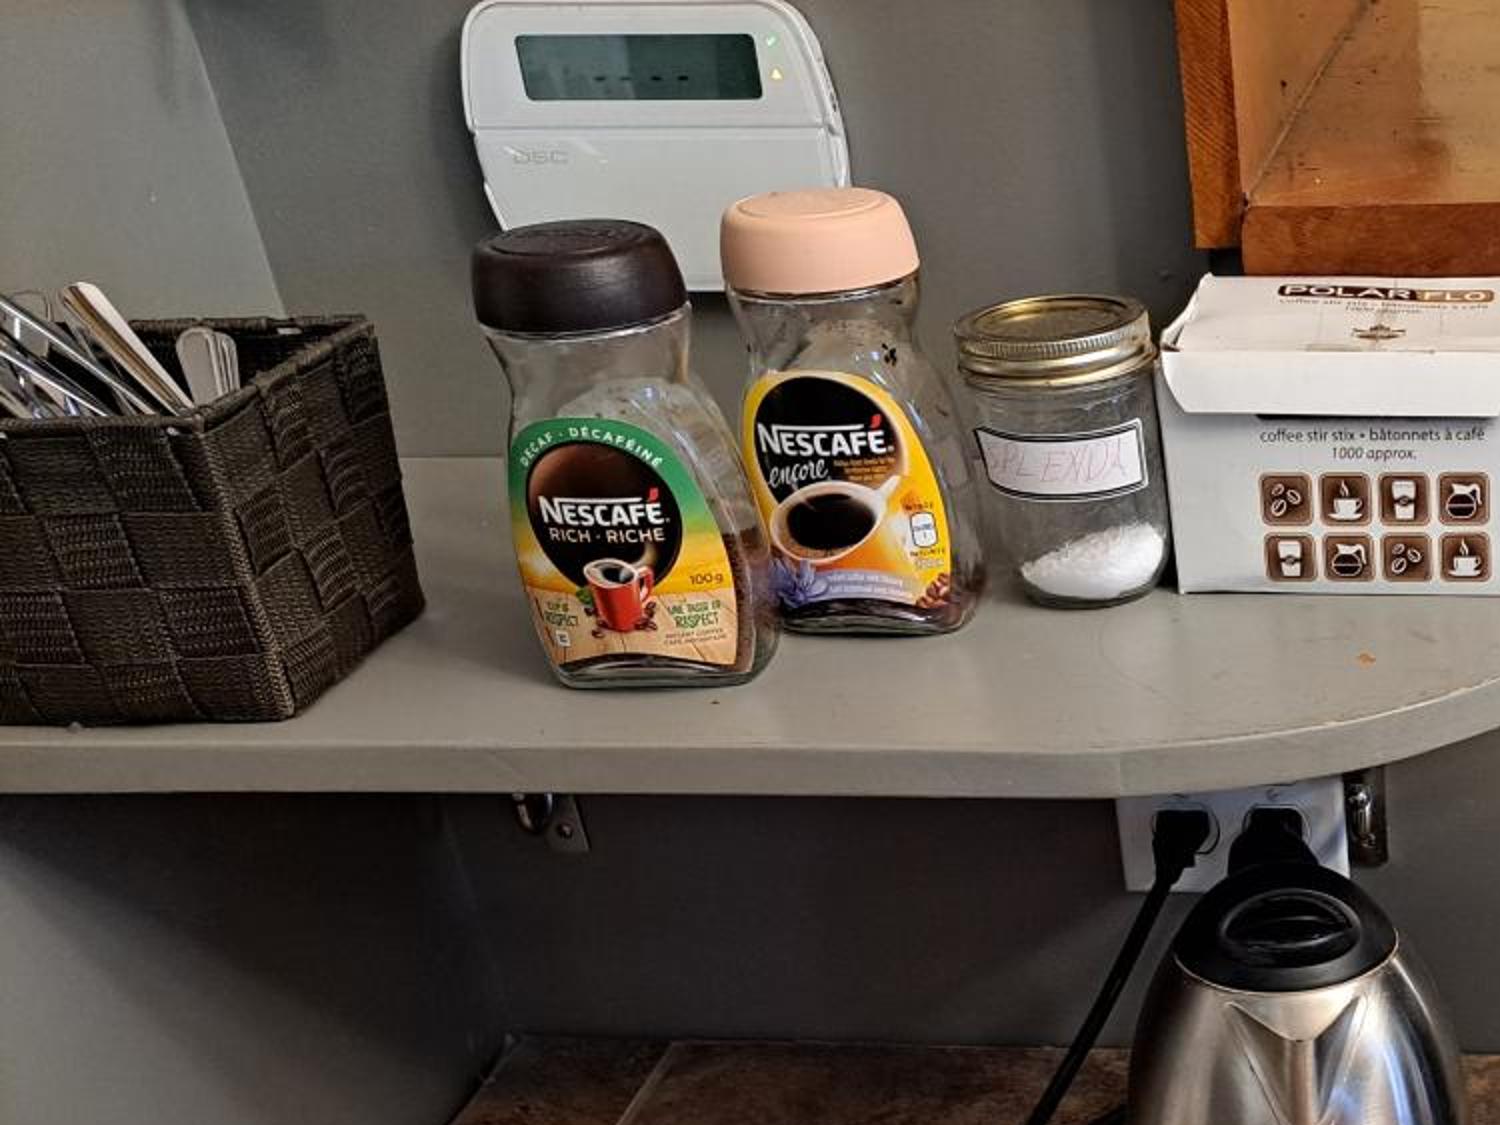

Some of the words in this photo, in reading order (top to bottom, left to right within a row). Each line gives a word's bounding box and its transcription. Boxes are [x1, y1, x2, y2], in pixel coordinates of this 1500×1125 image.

[1284, 286, 1411, 300] POLAR
[1423, 291, 1486, 301] FLO
[758, 414, 887, 457] NESCAFÉ
[1259, 428, 1304, 443] coffee
[1306, 428, 1328, 442] stir
[1330, 428, 1355, 442] stix
[1368, 427, 1441, 442] bâtonnets
[1455, 426, 1486, 441] café
[1332, 446, 1364, 460] 1000
[538, 487, 665, 527] NESCAFÉ
[548, 527, 592, 543] RICH
[605, 527, 667, 543] RICHE
